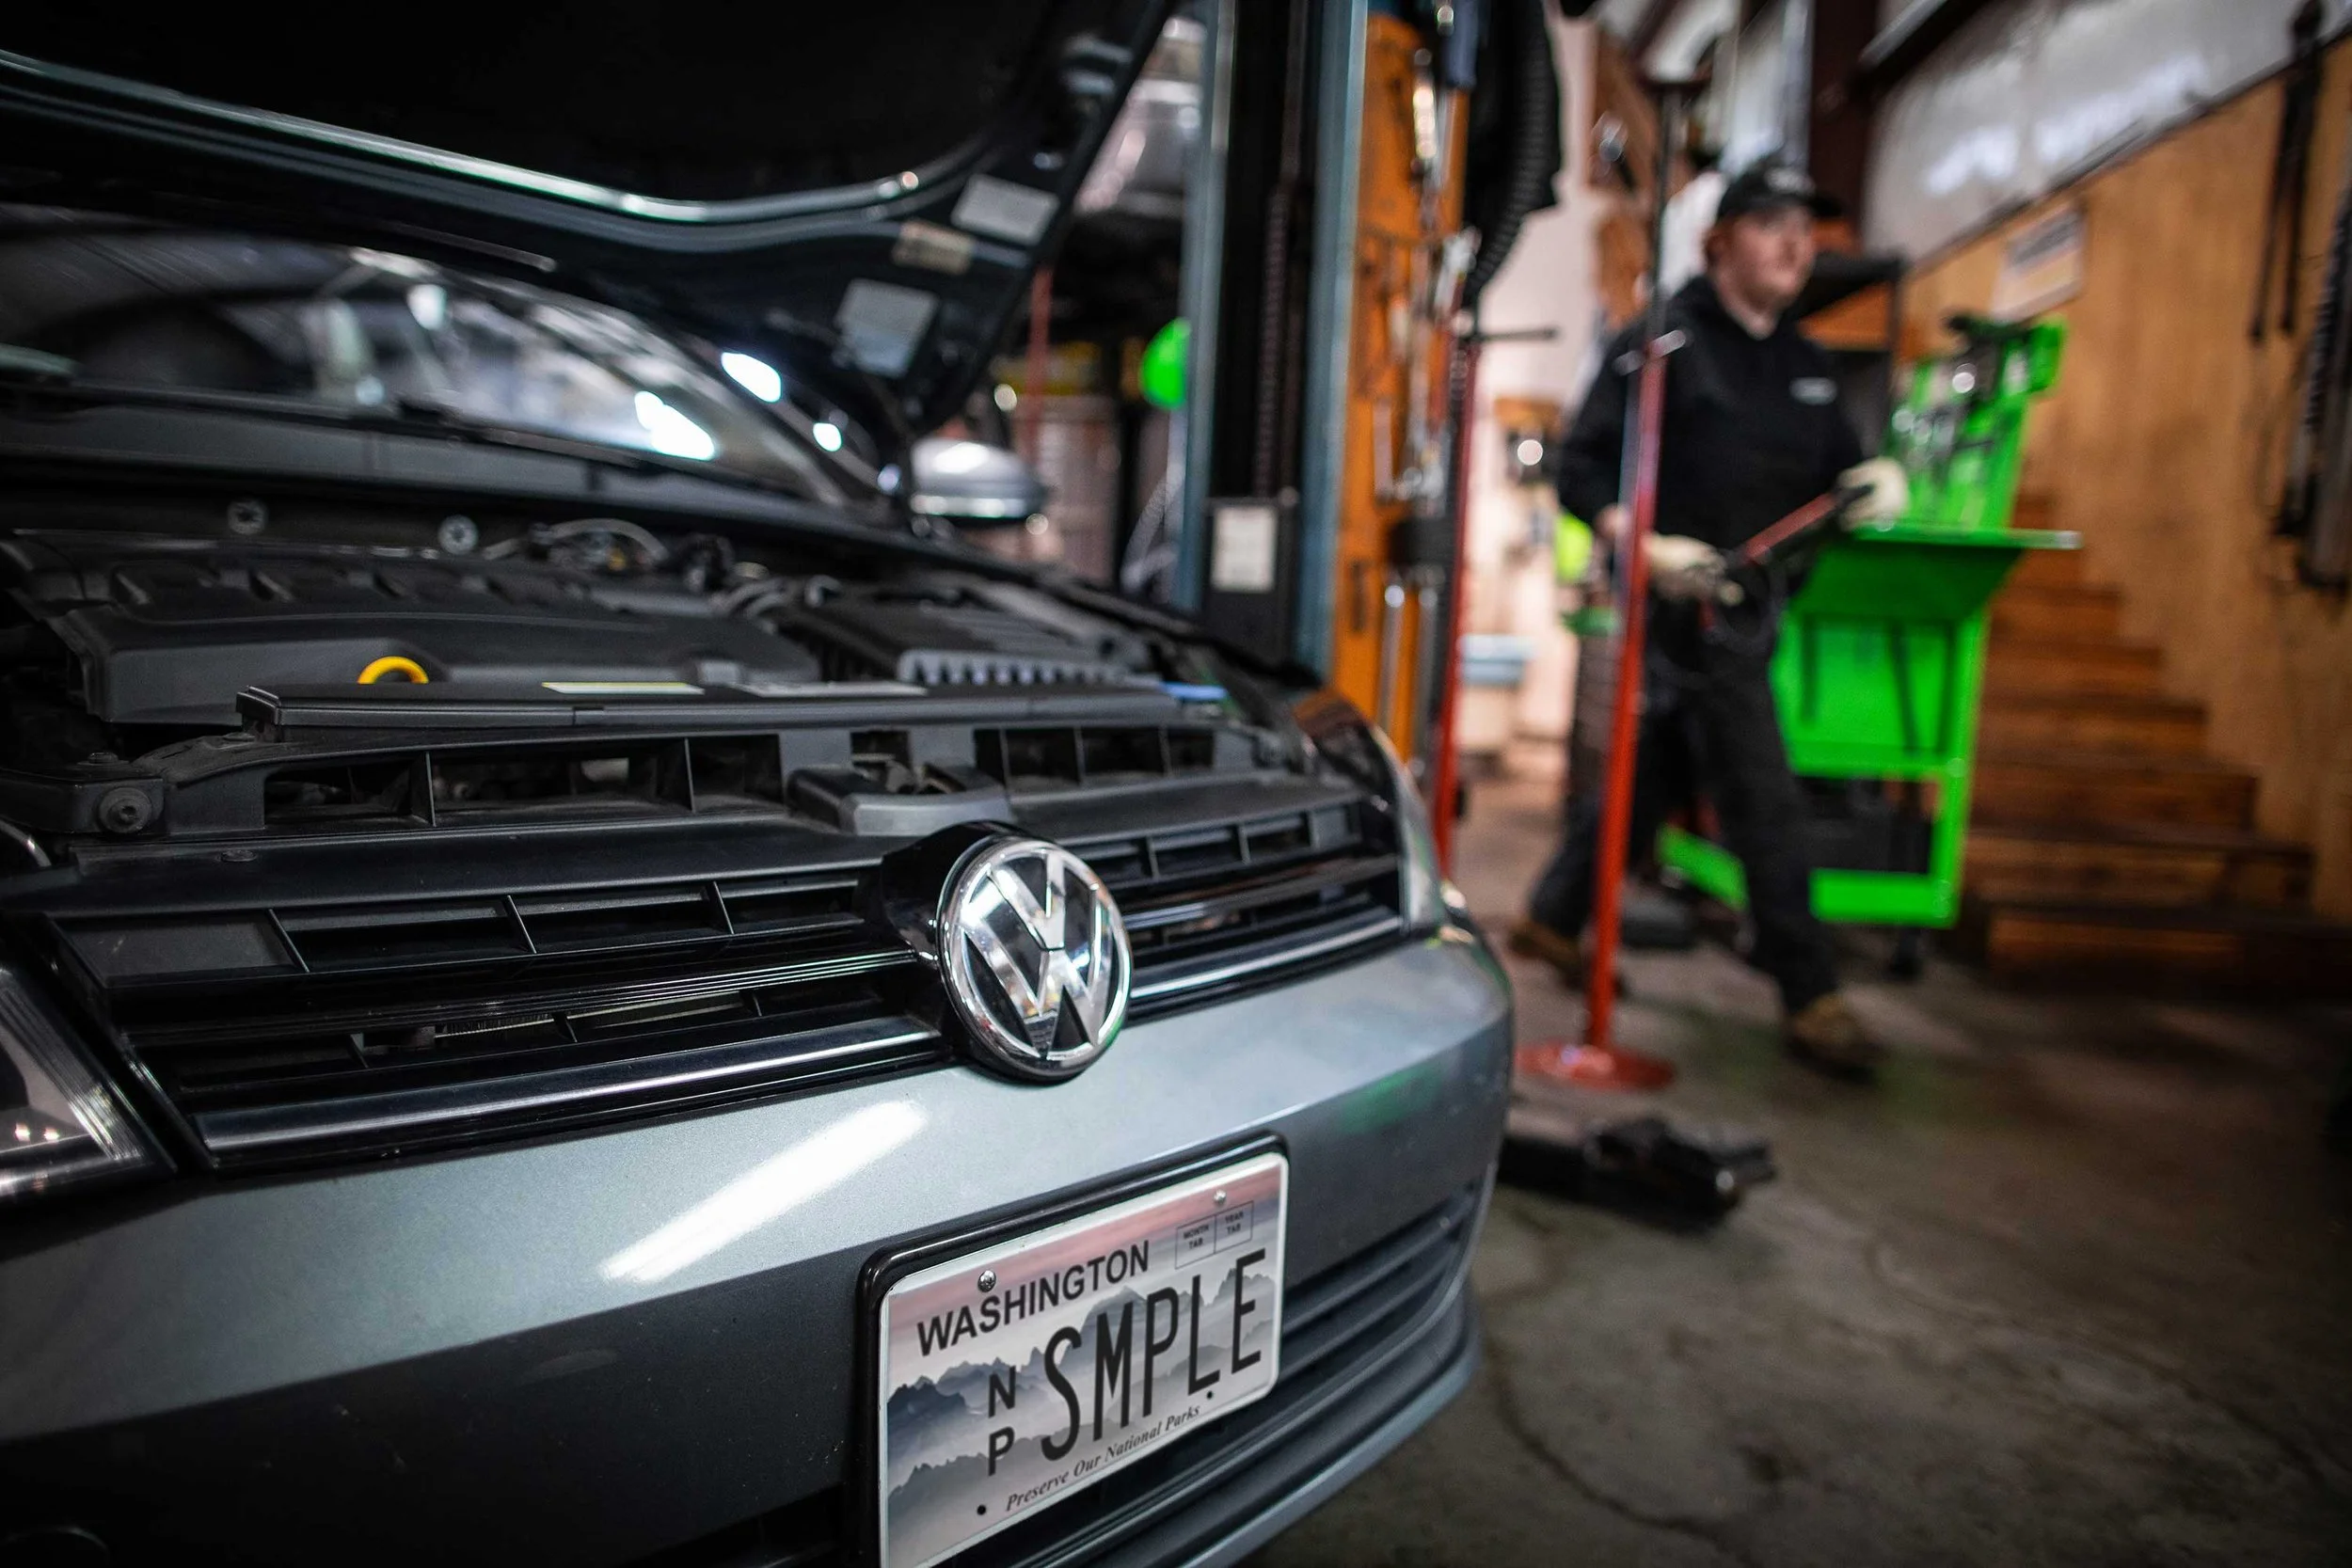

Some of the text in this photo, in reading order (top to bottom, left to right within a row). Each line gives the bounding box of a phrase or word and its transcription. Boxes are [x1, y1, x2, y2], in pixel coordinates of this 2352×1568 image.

[959, 850, 1114, 1060] VW
[1184, 1225, 1209, 1239] MONTH
[1188, 1237, 1203, 1249] TAB
[1225, 1212, 1244, 1223] YEAR
[1227, 1223, 1241, 1235] TAB
[916, 1240, 1150, 1356] WASHINGTON
[1041, 1248, 1266, 1462] SMPLE
[1006, 1404, 1200, 1512] Preserve Our National Parks
